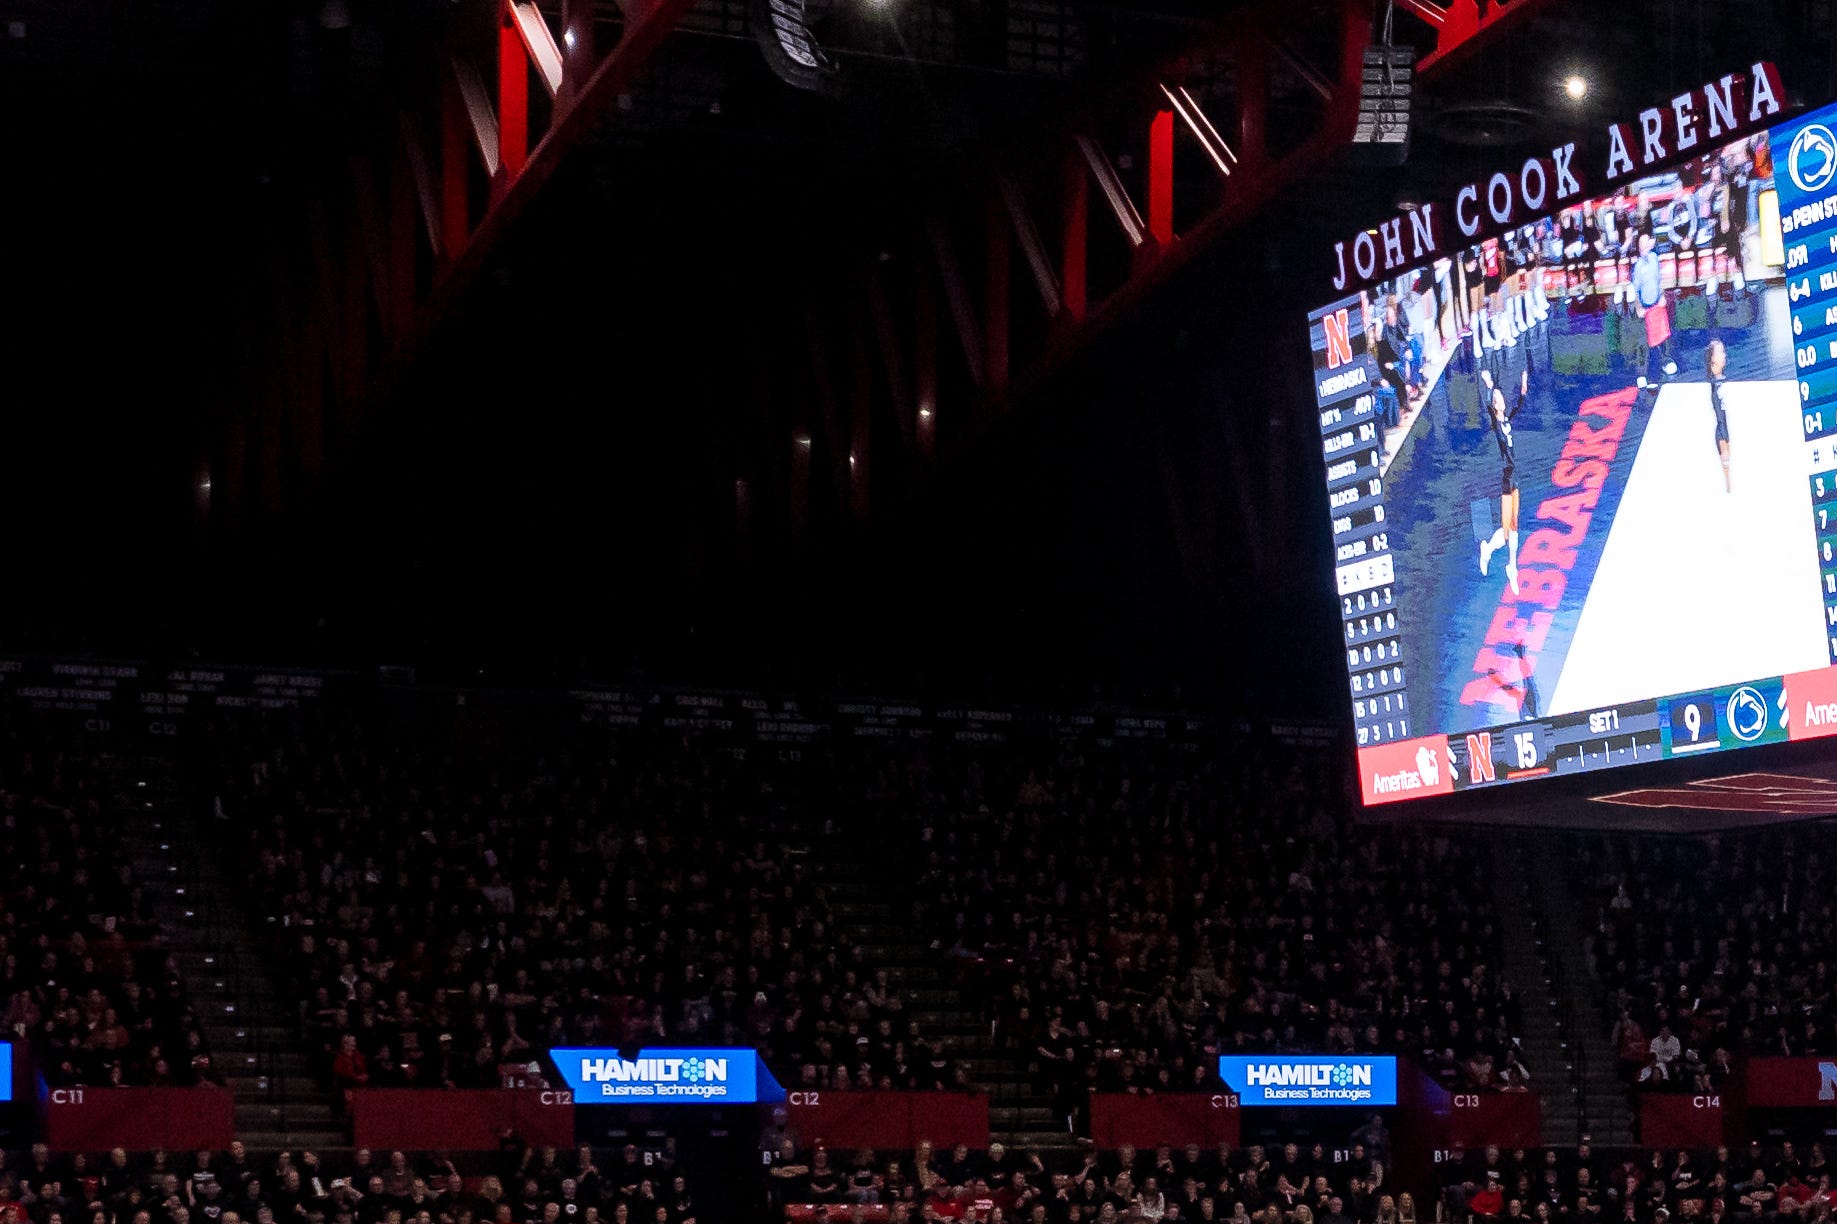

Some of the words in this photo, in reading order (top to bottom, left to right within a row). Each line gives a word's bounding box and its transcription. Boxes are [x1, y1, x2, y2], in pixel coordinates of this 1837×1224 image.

[1332, 205, 1437, 291] JOHN
[1456, 142, 1580, 238] COOK
[1606, 61, 1780, 180] ARENA
[1792, 202, 1824, 229] PENN
[1790, 277, 1811, 302] 6-4
[1794, 316, 1803, 335] 6
[1323, 309, 1353, 370] N
[1798, 345, 1817, 368] 0.0
[1800, 381, 1809, 401] 9
[1805, 412, 1823, 434] 0-1
[1816, 478, 1824, 498] 3
[1818, 509, 1827, 530] 7
[1466, 732, 1496, 783] N
[1514, 733, 1537, 769] 15
[1589, 713, 1611, 734] SET
[1684, 704, 1701, 742] 9
[1374, 771, 1422, 794] Ameritas
[582, 1057, 728, 1083] HAMILTON
[1247, 1063, 1372, 1087] HAMILTON
[52, 1089, 84, 1105] C11
[540, 1091, 573, 1106] C12
[602, 1083, 653, 1097] Business
[653, 1083, 727, 1098] Technologies
[789, 1091, 820, 1107] C12
[1264, 1088, 1308, 1100] Business
[1308, 1087, 1371, 1101] Technologies
[1211, 1094, 1238, 1109] C13
[1454, 1094, 1479, 1109] C13
[1693, 1095, 1720, 1109] C14
